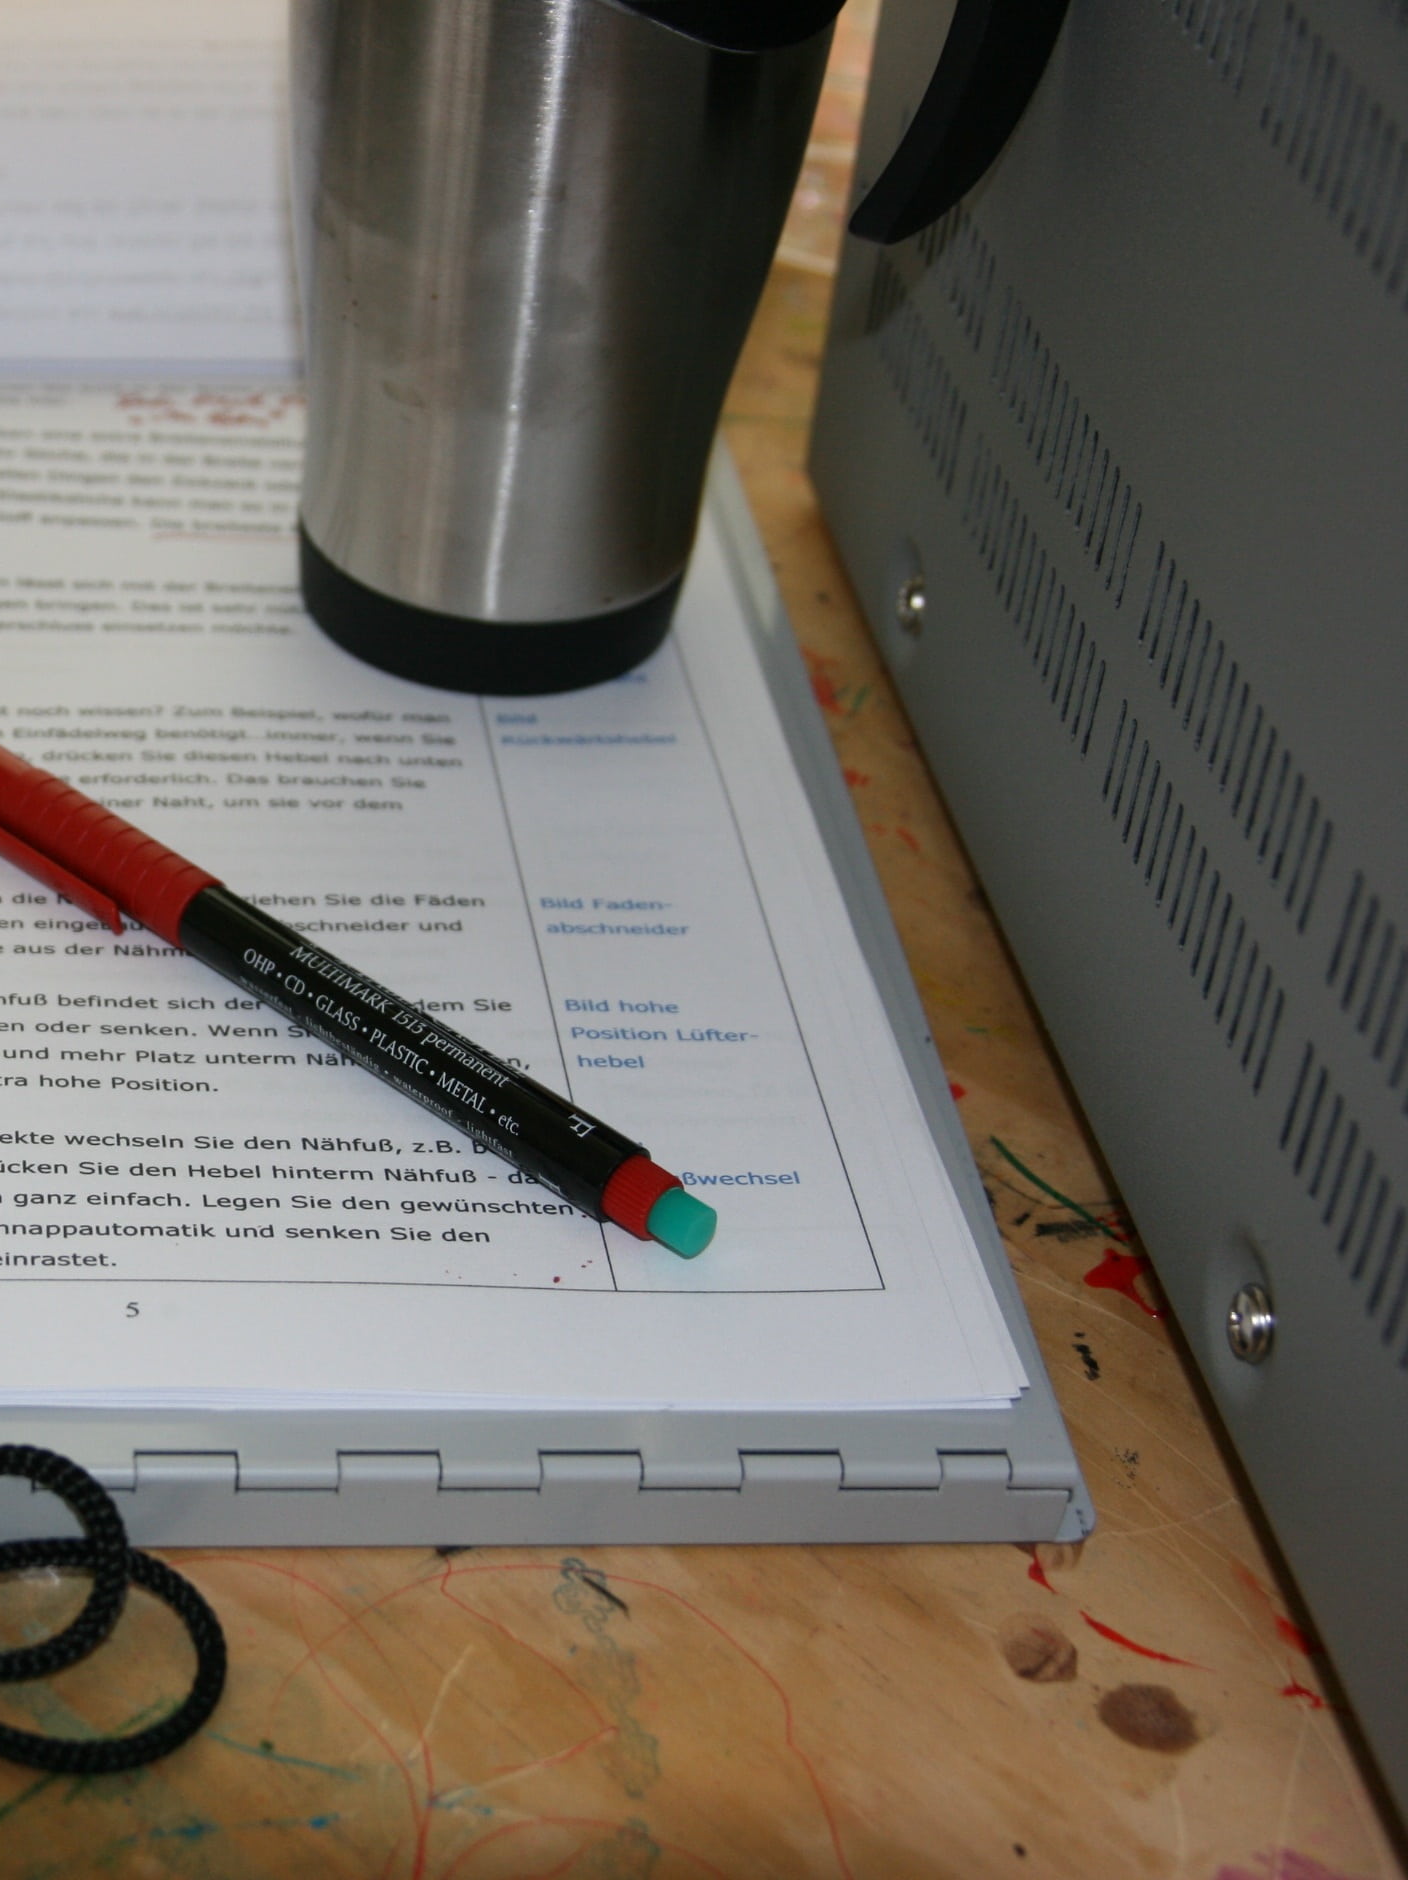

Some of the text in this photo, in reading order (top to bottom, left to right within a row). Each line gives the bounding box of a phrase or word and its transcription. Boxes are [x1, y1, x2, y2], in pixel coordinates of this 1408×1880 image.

[17, 706, 70, 716] noch
[78, 706, 163, 717] wissen?
[174, 706, 222, 717] Zum
[231, 707, 323, 720] Beispiel,
[402, 714, 450, 723] man
[79, 773, 216, 784] erforderlich.
[226, 773, 269, 785] Das
[277, 774, 382, 787] brauchen
[391, 777, 426, 789] Sie
[153, 798, 214, 809] Naht,
[224, 799, 259, 808] um
[268, 798, 299, 808] sie
[309, 800, 344, 808] vor
[353, 798, 403, 810] dem
[12, 892, 48, 904] die
[325, 894, 361, 906] Sie
[370, 894, 405, 906] die
[414, 894, 485, 907] Fäden
[540, 897, 672, 911] Bild Faden-
[419, 920, 463, 932] und
[547, 921, 689, 936] abschneider
[13, 945, 56, 954] aus
[65, 944, 104, 955] der
[58, 994, 158, 1009] befindet
[168, 997, 215, 1009] sich
[224, 995, 261, 1012] der
[473, 999, 512, 1012] Sie
[565, 998, 679, 1014] Bild hohe
[290, 946, 393, 1014] MULTIMARK
[421, 1031, 511, 1088] permanent
[35, 1021, 91, 1033] oder
[100, 1023, 197, 1037] senken.
[208, 1025, 278, 1037] Wenn
[572, 1026, 758, 1042] Position Lüfter-
[243, 948, 520, 1137] OHP CD GLASS PLASTIC METAL etc.
[3, 1047, 49, 1060] und
[61, 1049, 126, 1062] mehr
[136, 1050, 196, 1064] Platz
[205, 1052, 296, 1065] unterm
[578, 1054, 644, 1069] hebel
[40, 1074, 101, 1089] hohe
[111, 1077, 218, 1092] Position.
[393, 1075, 454, 1117] waterproof
[465, 1121, 514, 1156] lightfast
[64, 1133, 184, 1148] wechseln
[194, 1136, 234, 1149] Sie
[244, 1136, 291, 1150] den
[301, 1137, 402, 1155] Nähfuß,
[412, 1140, 461, 1153] z.B.
[79, 1161, 119, 1175] Sie
[129, 1163, 176, 1177] den
[188, 1165, 261, 1178] Hebel
[272, 1165, 373, 1181] hinterm
[384, 1168, 477, 1183] Nähfuß
[682, 1171, 801, 1186] ßwechsel
[13, 1193, 77, 1207] ganz
[87, 1192, 190, 1207] einfach.
[203, 1194, 280, 1211] Legen
[291, 1195, 332, 1209] Sie
[345, 1196, 390, 1210] den
[400, 1199, 574, 1215] gewünschten
[226, 1224, 274, 1238] und
[285, 1225, 380, 1240] senken
[390, 1227, 431, 1241] Sie
[442, 1228, 490, 1243] den
[126, 1302, 139, 1318] 5
